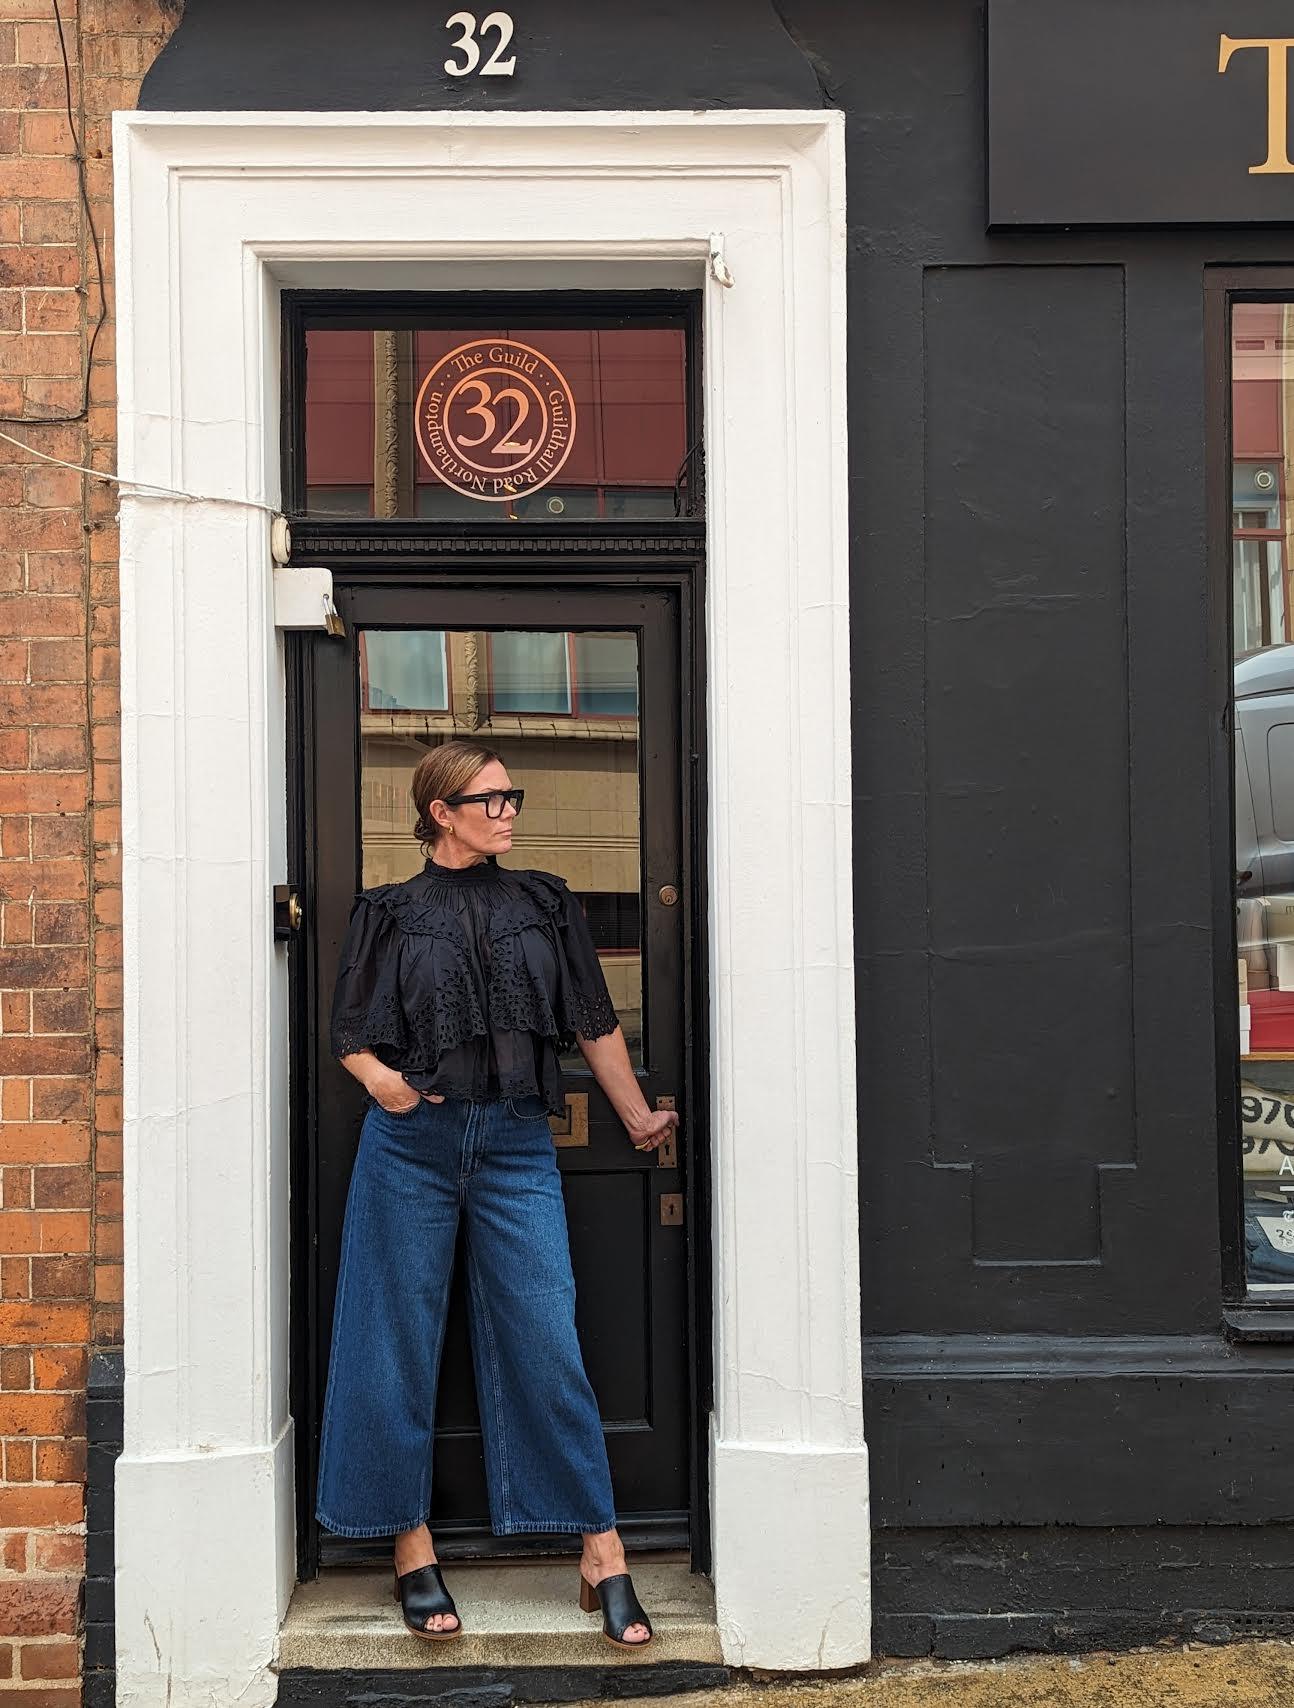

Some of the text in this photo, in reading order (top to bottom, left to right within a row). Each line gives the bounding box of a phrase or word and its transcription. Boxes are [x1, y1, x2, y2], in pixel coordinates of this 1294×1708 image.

[444, 11, 517, 76] 32
[1218, 33, 1294, 174] T
[451, 347, 539, 374] The Guild
[425, 390, 569, 494] Guildhall Road Northampton
[456, 380, 533, 454] 32
